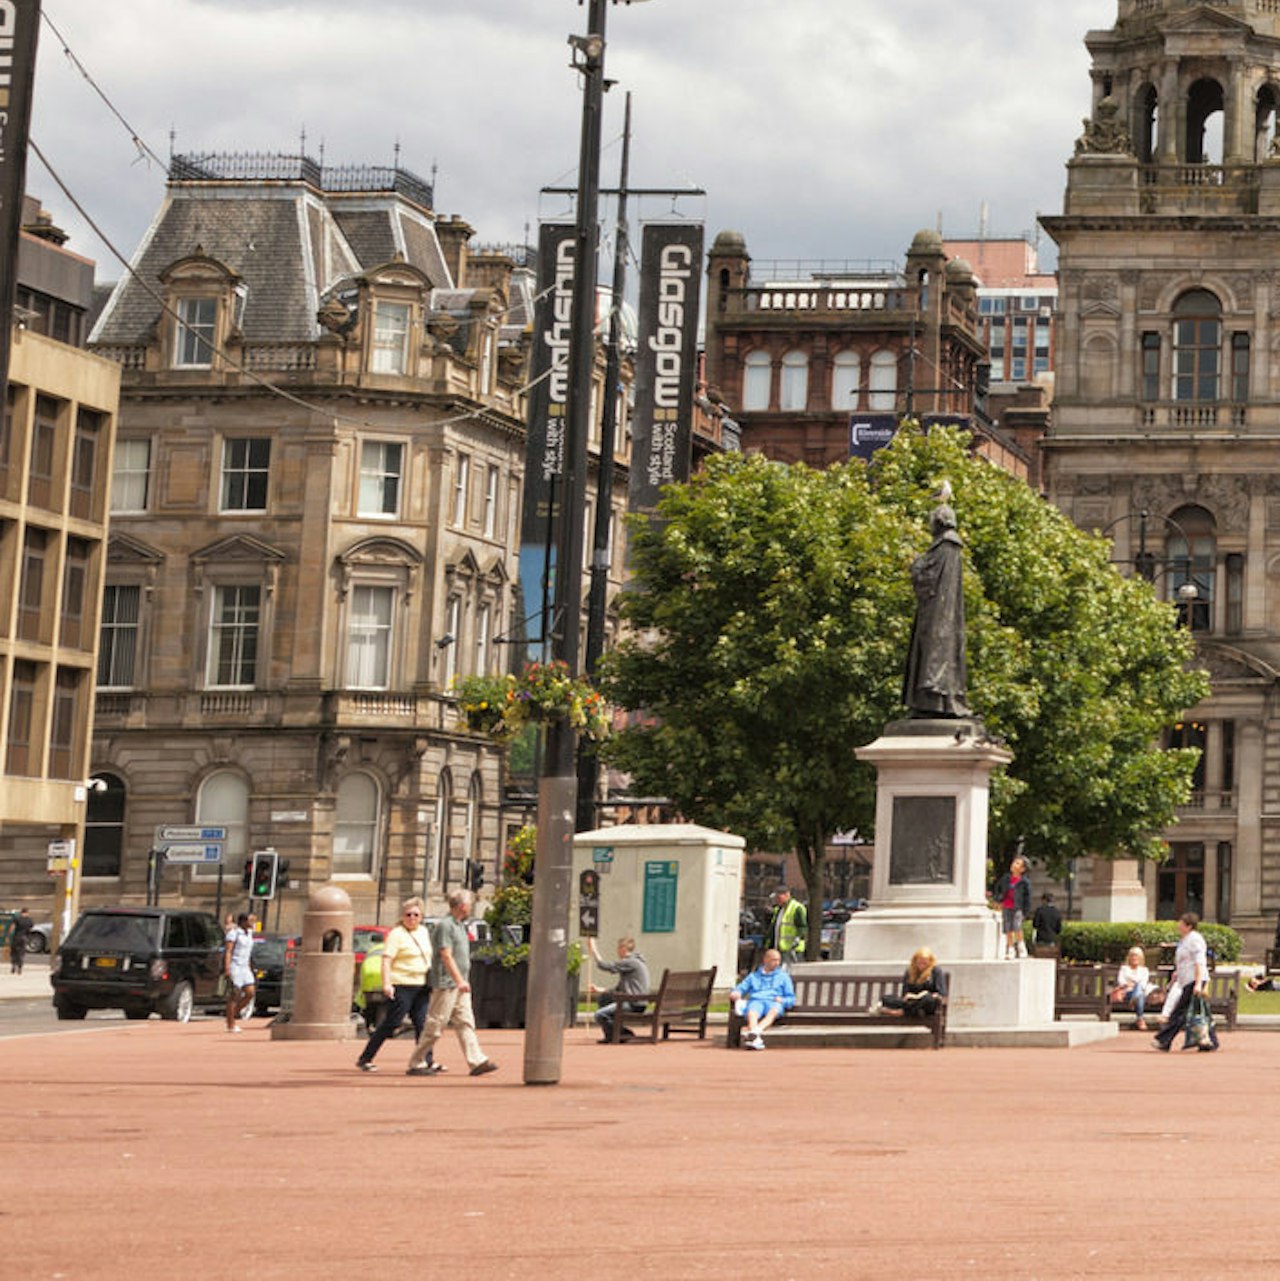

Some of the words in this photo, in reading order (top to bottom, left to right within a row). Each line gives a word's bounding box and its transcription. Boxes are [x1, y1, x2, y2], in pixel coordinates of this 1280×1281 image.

[648, 243, 692, 407] Glasgow
[546, 418, 559, 447] with
[651, 423, 664, 452] with
[662, 422, 678, 479] Scotland
[647, 454, 662, 486] style
